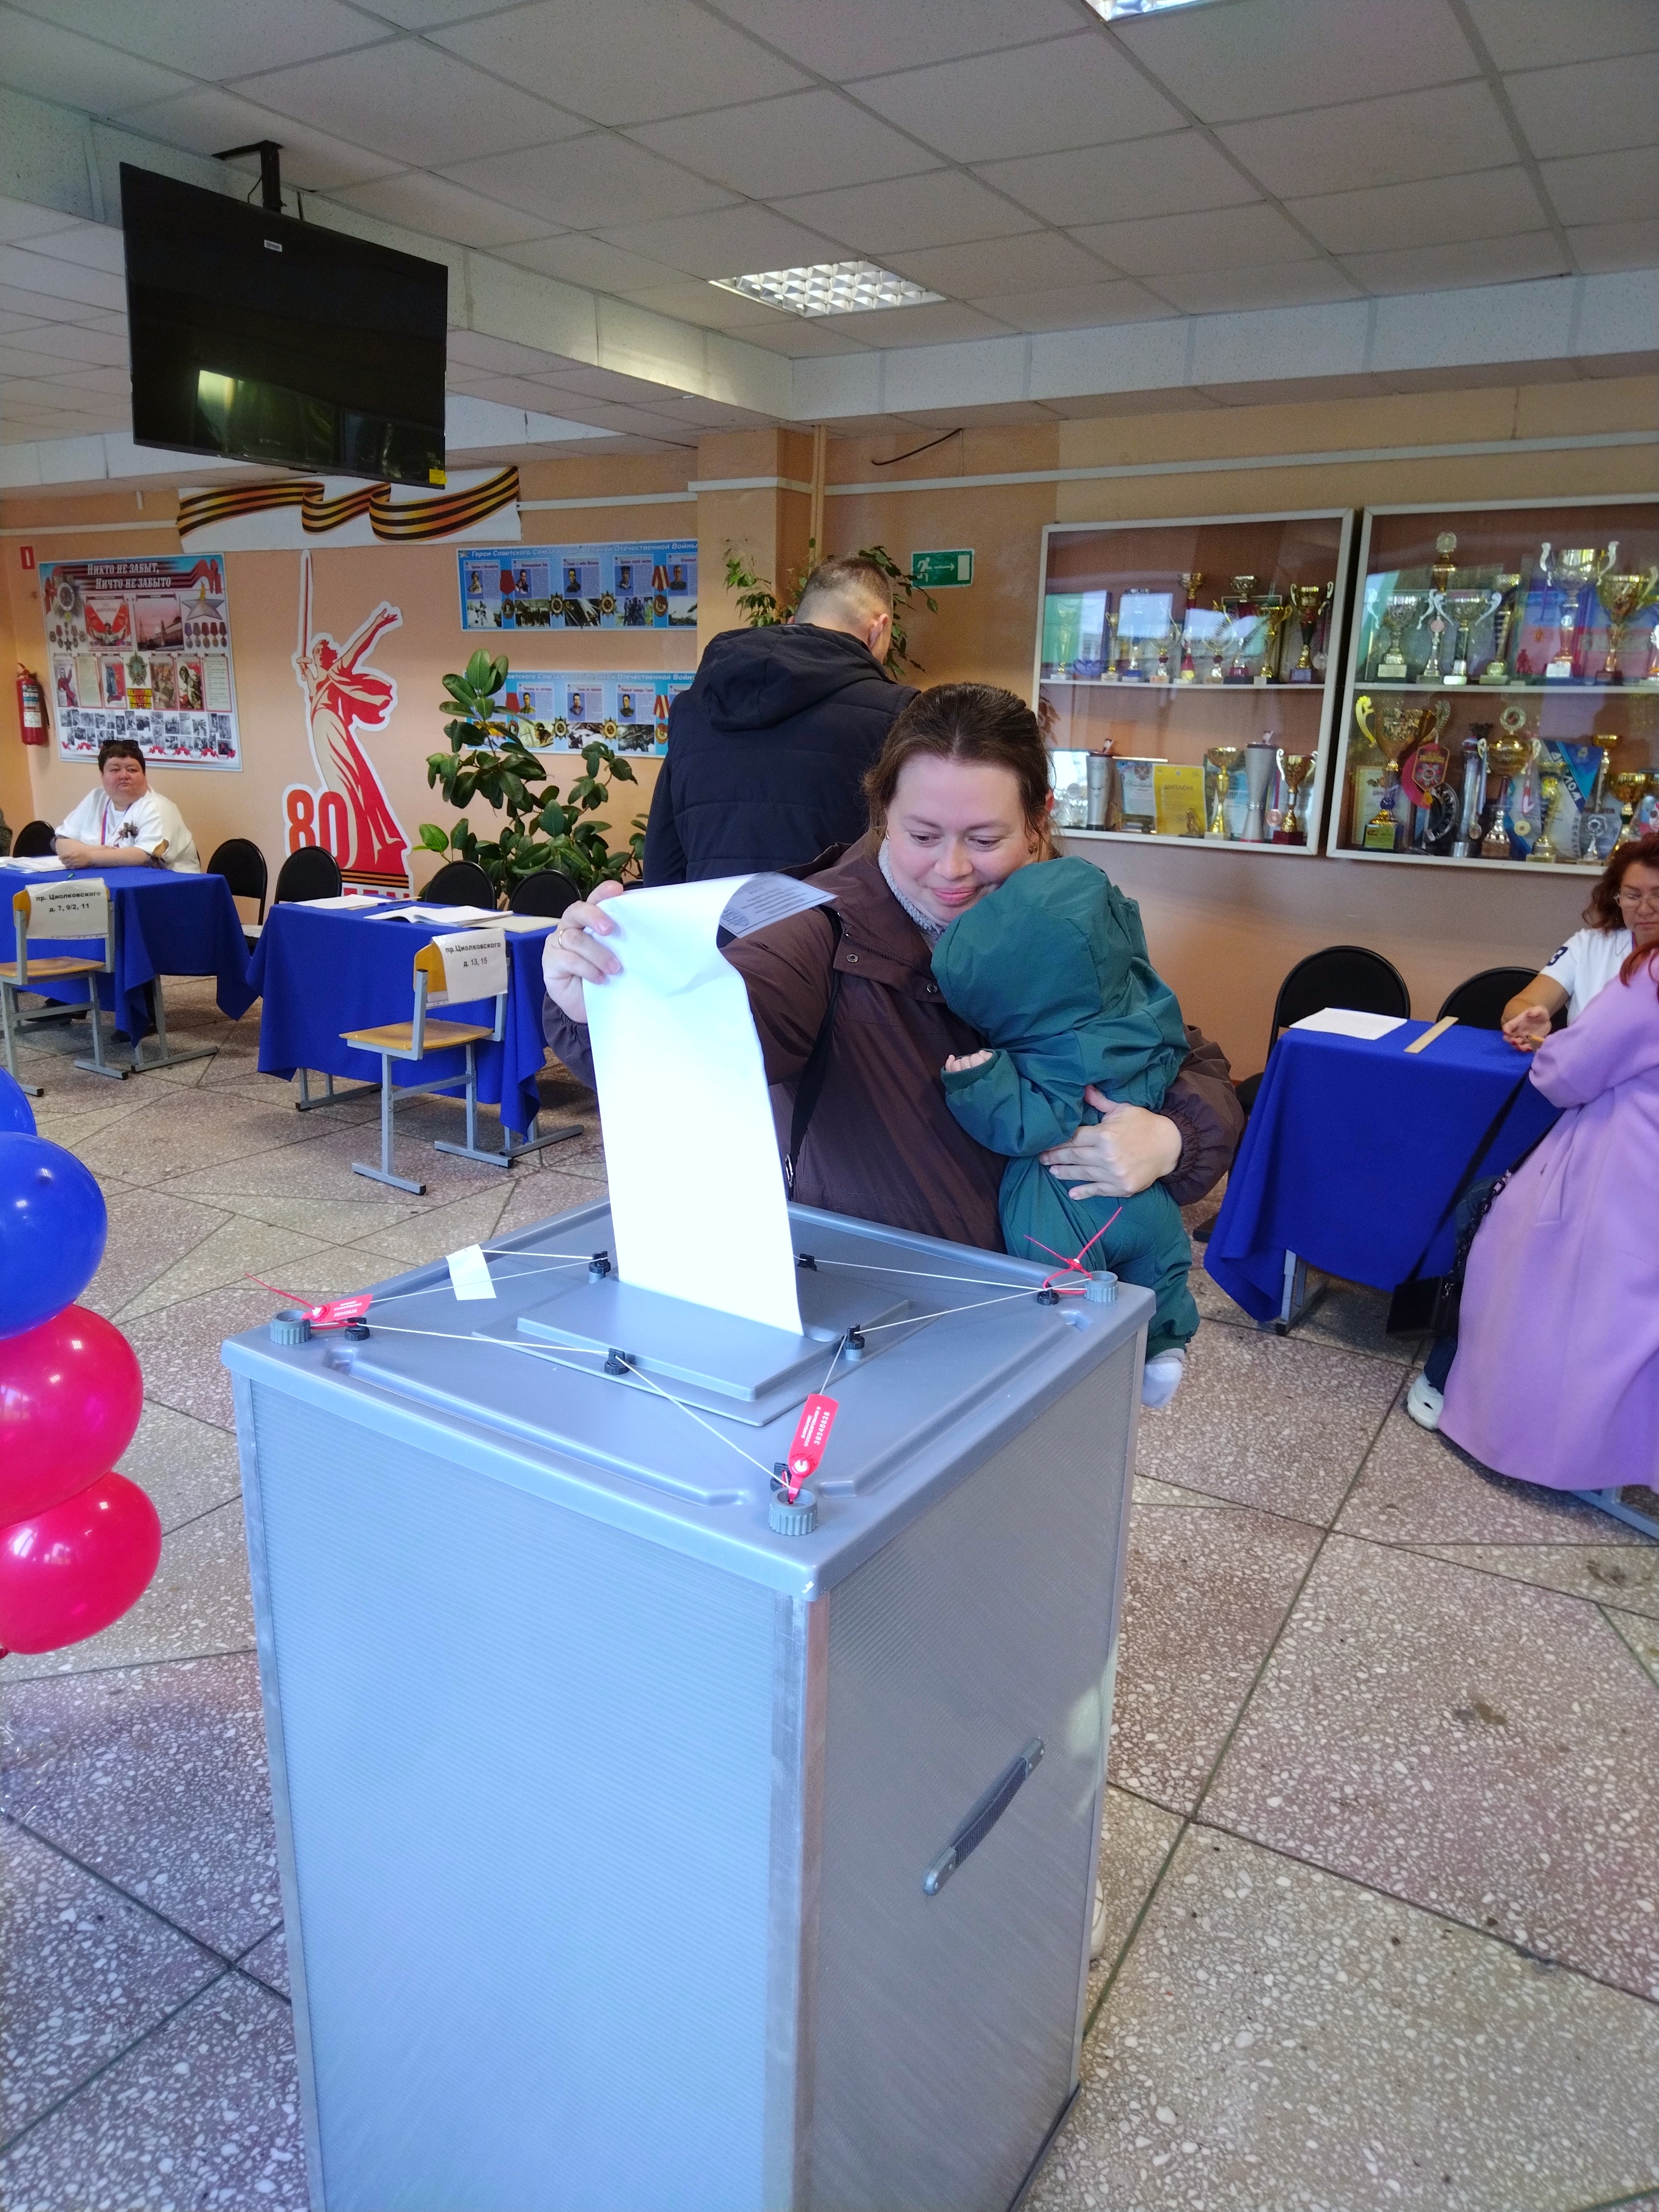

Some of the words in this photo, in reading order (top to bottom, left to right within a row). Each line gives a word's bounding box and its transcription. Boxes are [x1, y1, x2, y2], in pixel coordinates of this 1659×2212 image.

[614, 543, 670, 552] Отечественной
[117, 564, 128, 574] НЕ
[125, 578, 136, 589] НЕ
[287, 789, 350, 869] 80
[49, 891, 101, 901] Циолковского
[471, 958, 480, 966] 13,
